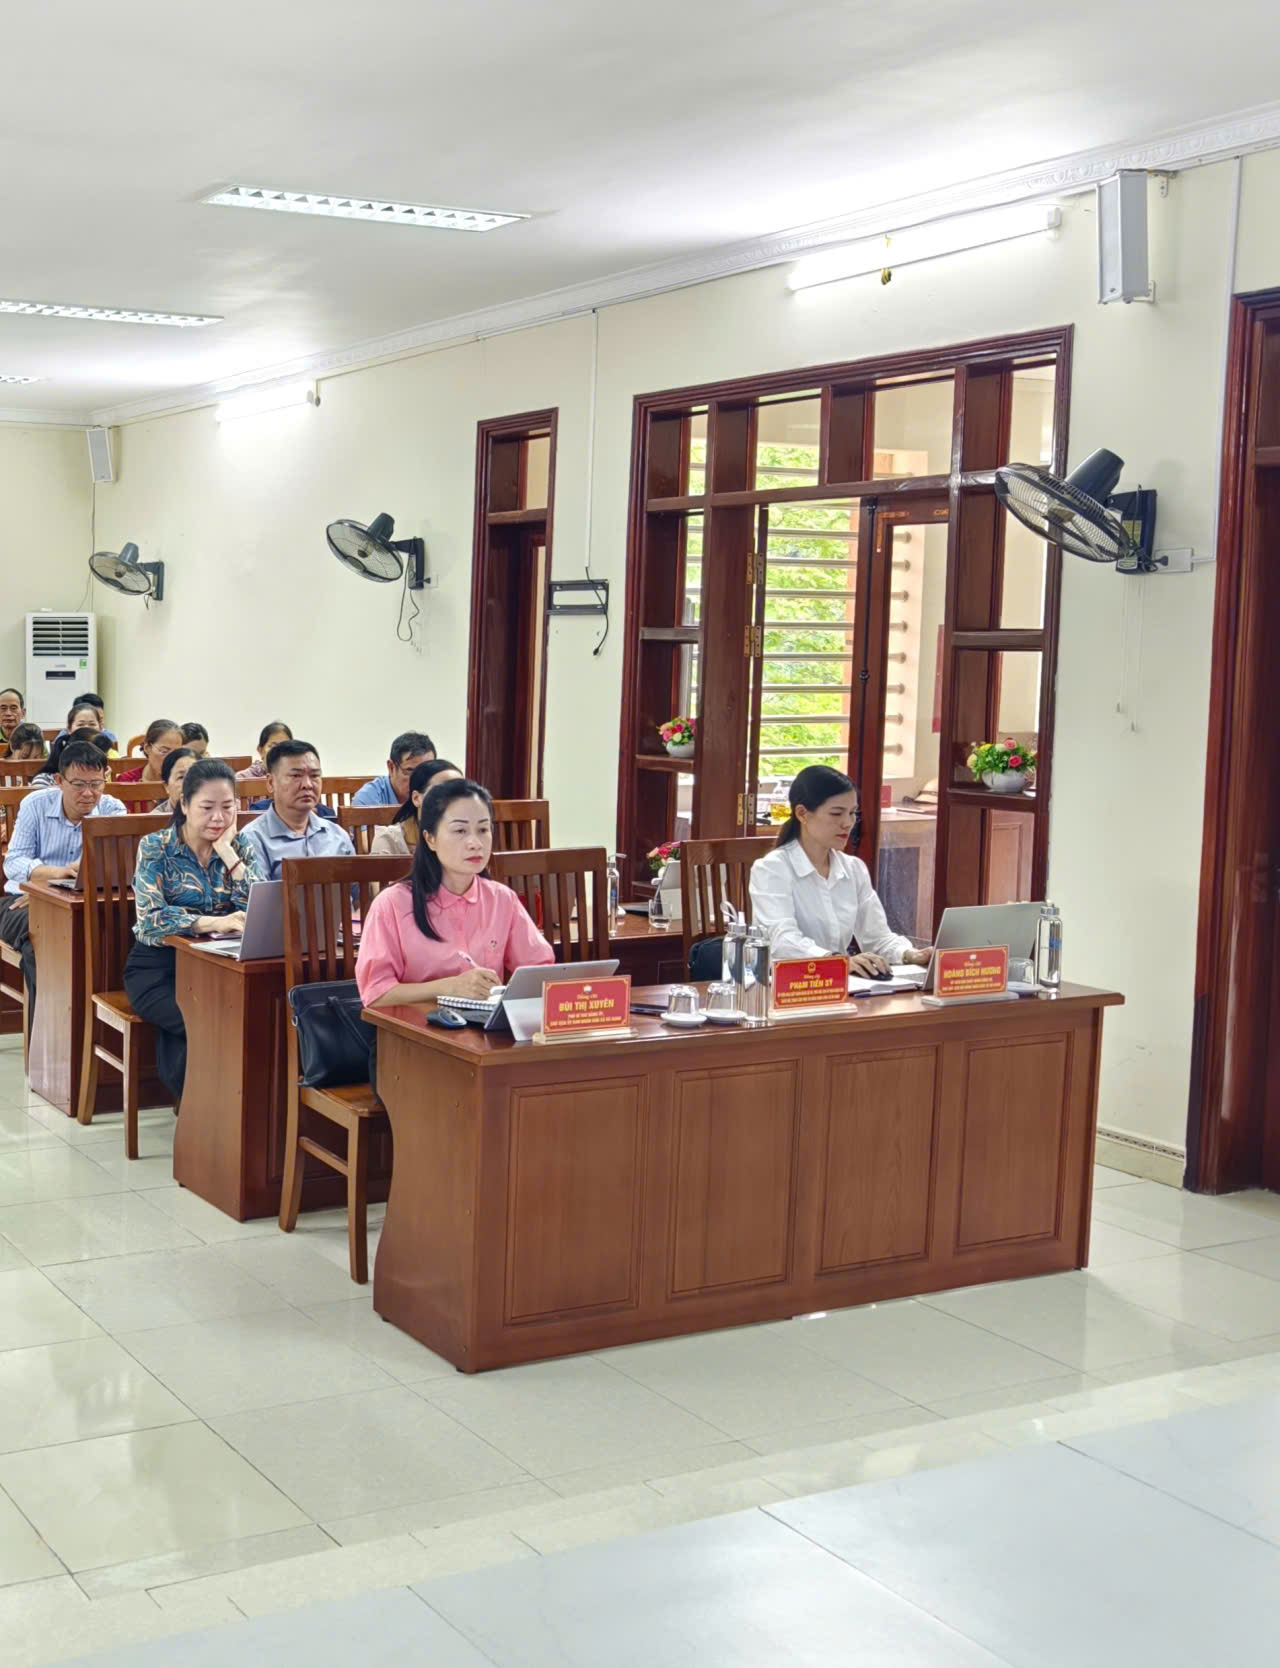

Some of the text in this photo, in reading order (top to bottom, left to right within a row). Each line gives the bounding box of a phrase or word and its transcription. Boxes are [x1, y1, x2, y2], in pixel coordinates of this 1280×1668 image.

[944, 968, 964, 979] HOÀNG
[790, 982, 808, 990] PHẠM
[810, 979, 823, 988] TIẾN
[559, 998, 614, 1012] BÙI THỊ XUYÊN
